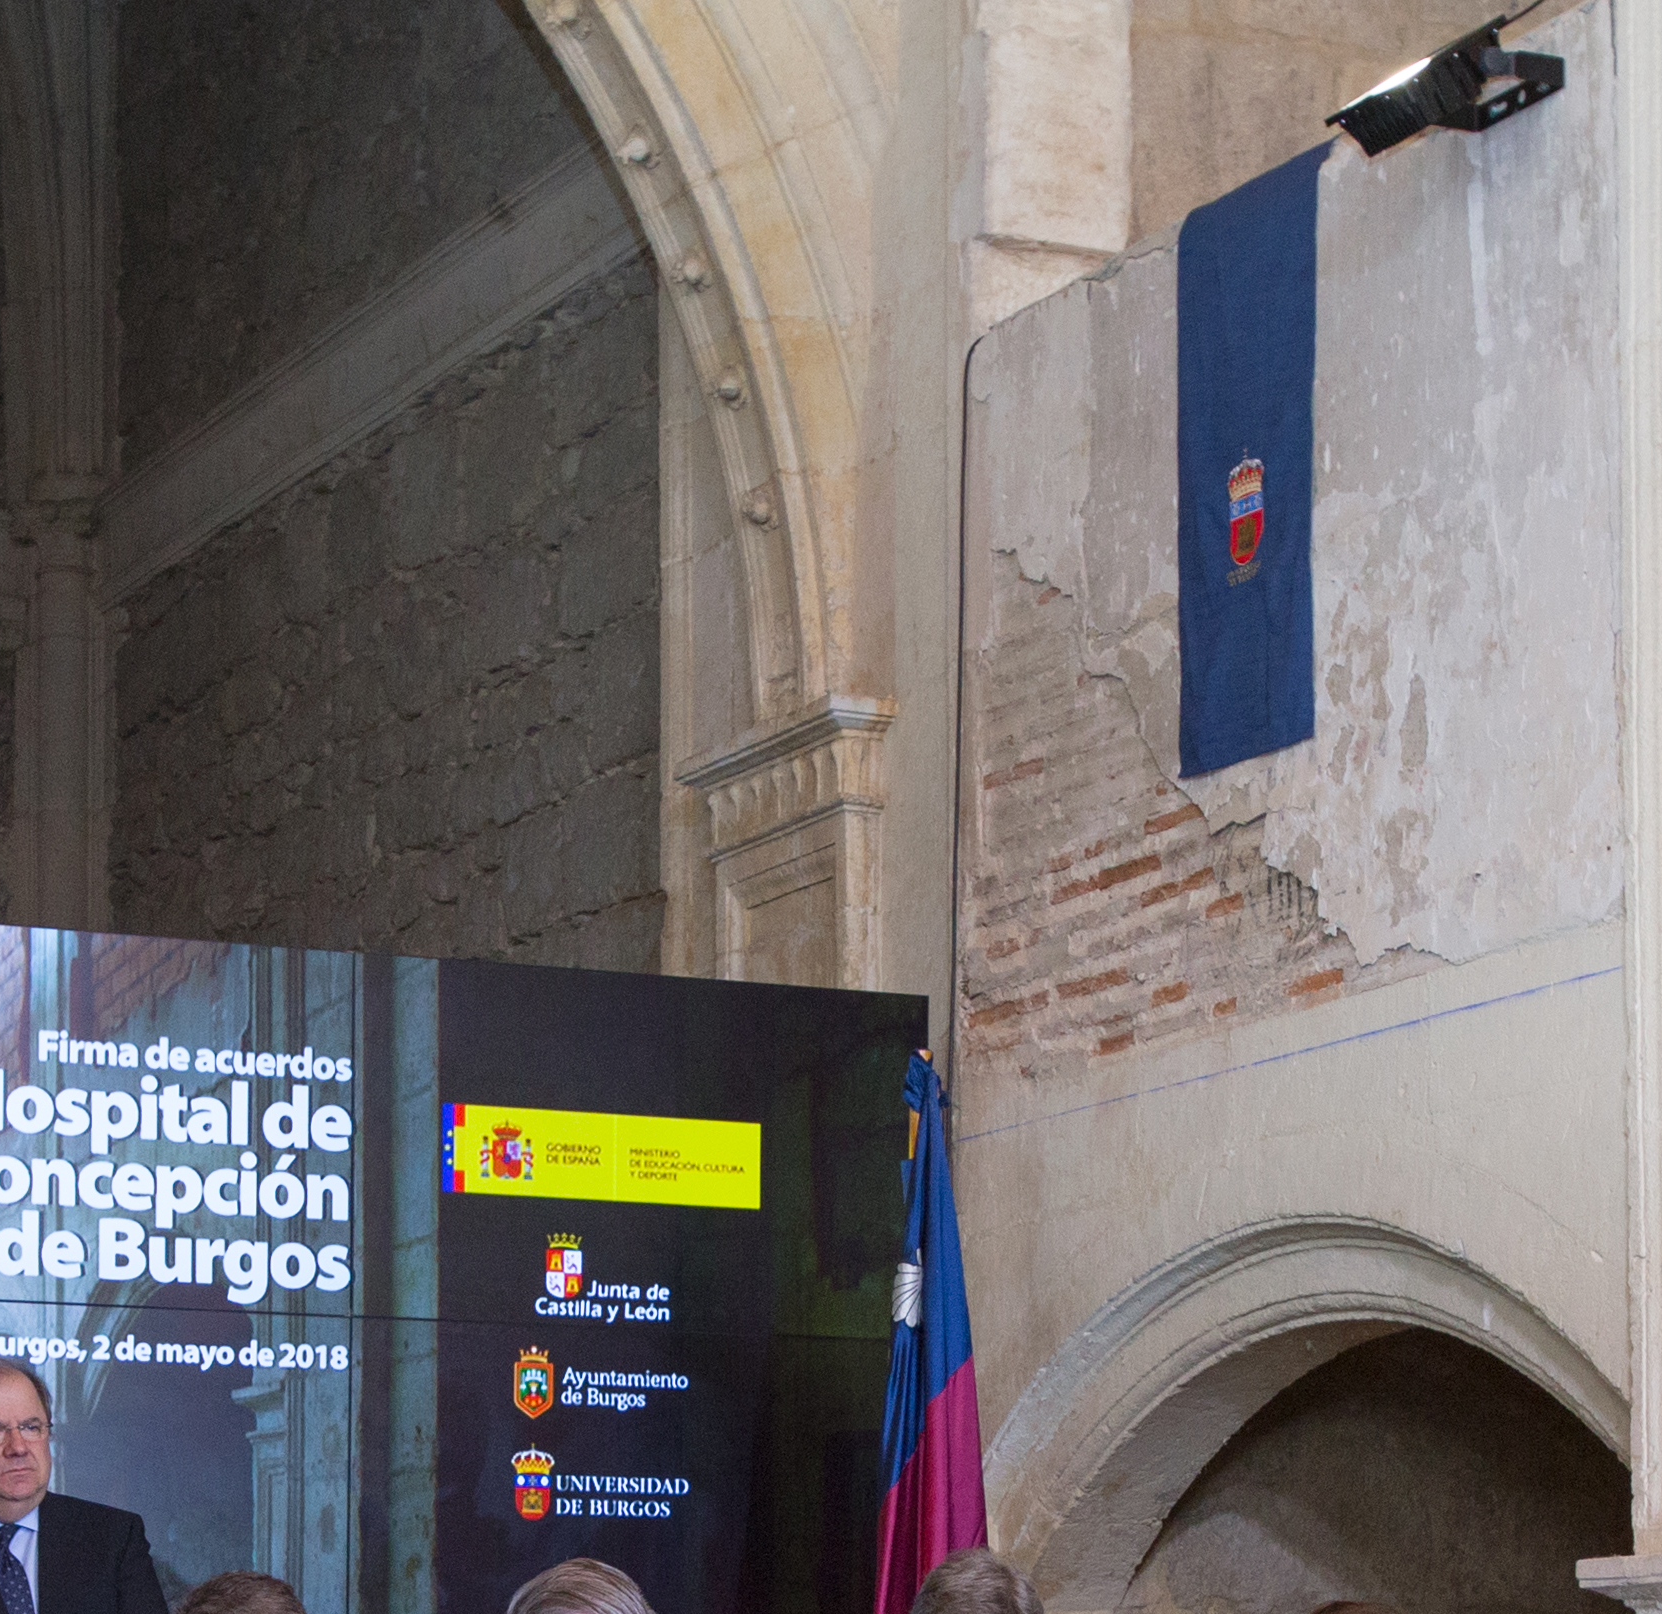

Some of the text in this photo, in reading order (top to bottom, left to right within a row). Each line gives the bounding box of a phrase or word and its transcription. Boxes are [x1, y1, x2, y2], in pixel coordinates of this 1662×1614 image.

[38, 1029, 353, 1082] Firma de acuerdos
[262, 1084, 353, 1151] de
[546, 1142, 601, 1155] GOBIERNO
[546, 1154, 559, 1163] DE
[629, 1148, 680, 1159] MINISTERIO
[629, 1159, 642, 1168] DE
[703, 1163, 745, 1174] CULTURA
[638, 1171, 677, 1181] DEPORTE
[98, 1217, 351, 1304] Burgos
[587, 1280, 670, 1301] Junta de
[535, 1297, 670, 1323] Castilla y León
[92, 1336, 111, 1361] 2
[114, 1334, 151, 1363] de
[156, 1341, 235, 1371] mayo
[239, 1340, 275, 1367] de
[279, 1343, 349, 1370] 2018
[562, 1366, 689, 1389] Ayuntamiento
[561, 1386, 646, 1412] de Burgos
[556, 1475, 689, 1494] UNIVERSIDAD
[556, 1498, 671, 1518] DE BURGOS
